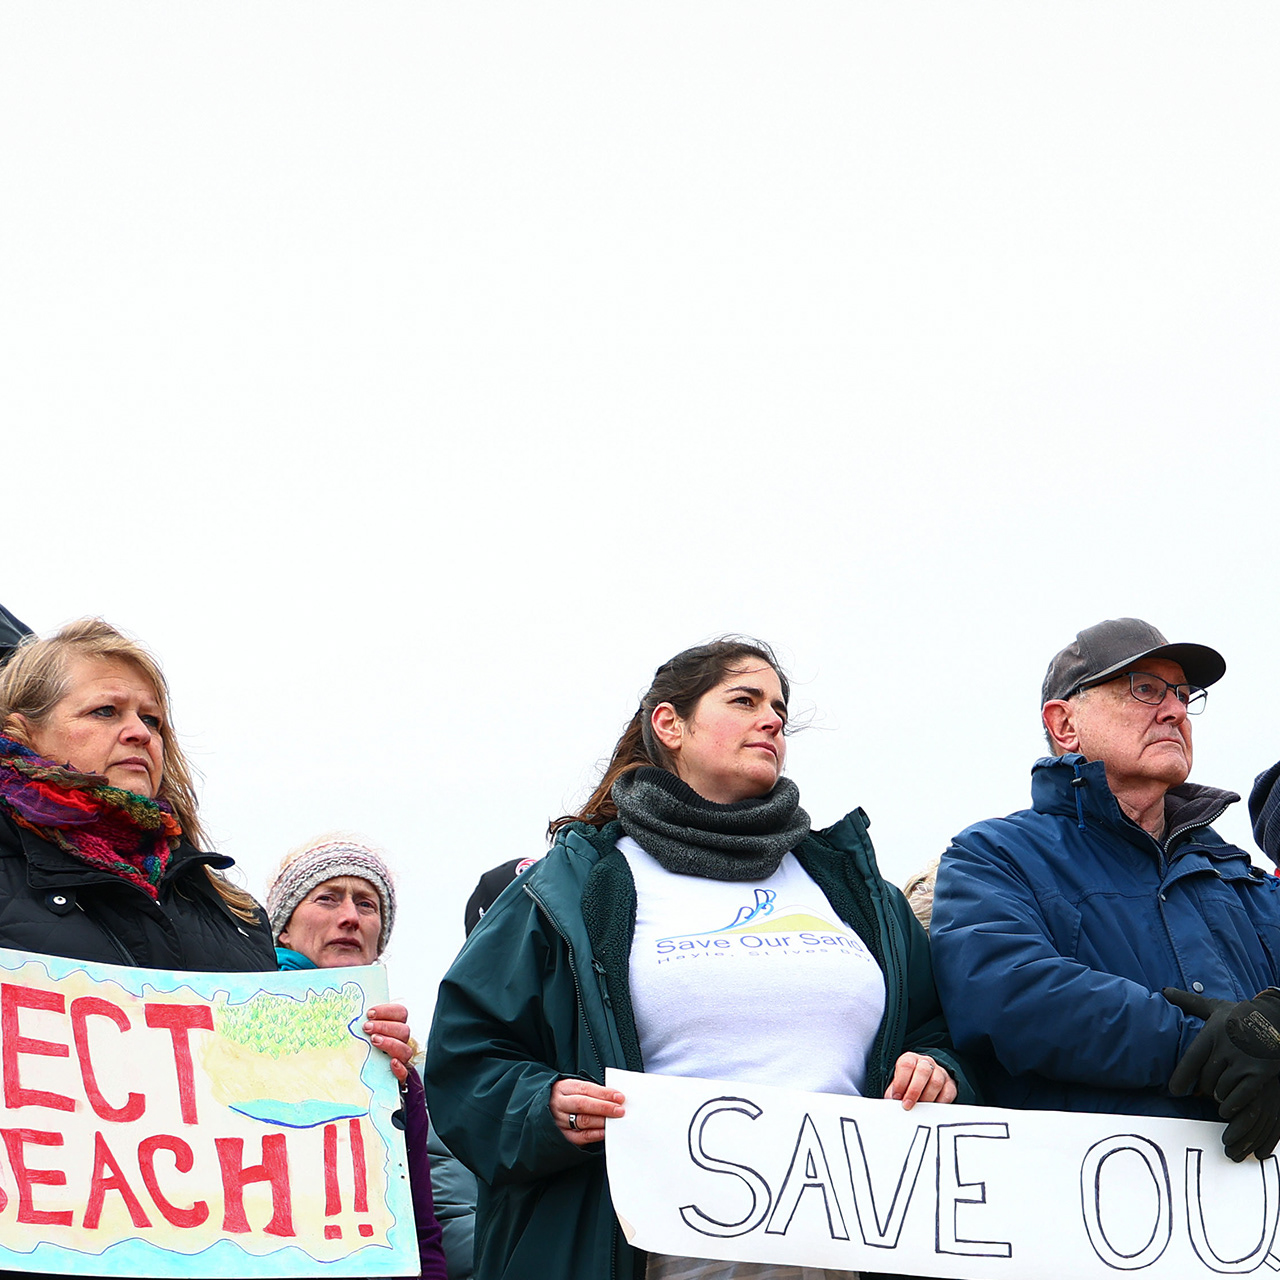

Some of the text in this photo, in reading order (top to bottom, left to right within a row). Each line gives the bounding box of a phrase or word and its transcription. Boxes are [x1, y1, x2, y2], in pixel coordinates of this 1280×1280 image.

[656, 932, 864, 954] Save Our Sand
[679, 1095, 1012, 1257] SAVE
